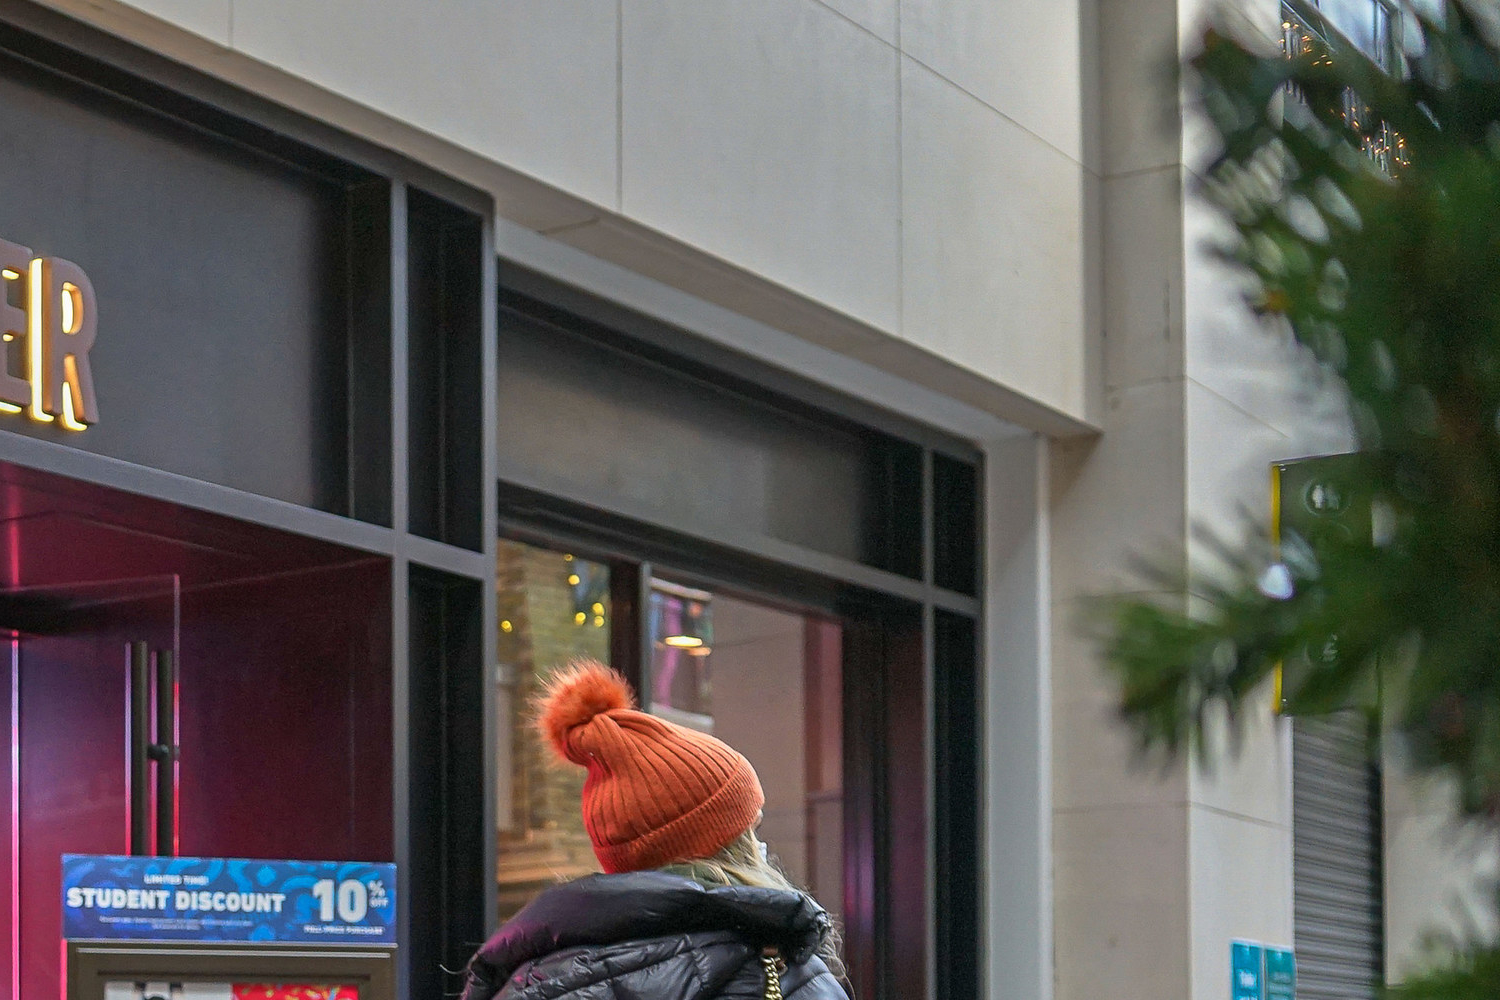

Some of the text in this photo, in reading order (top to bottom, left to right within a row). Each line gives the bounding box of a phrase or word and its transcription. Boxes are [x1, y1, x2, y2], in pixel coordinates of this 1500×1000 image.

[67, 888, 286, 913] STUDENT DISCOUNT
[313, 879, 367, 923] 10
